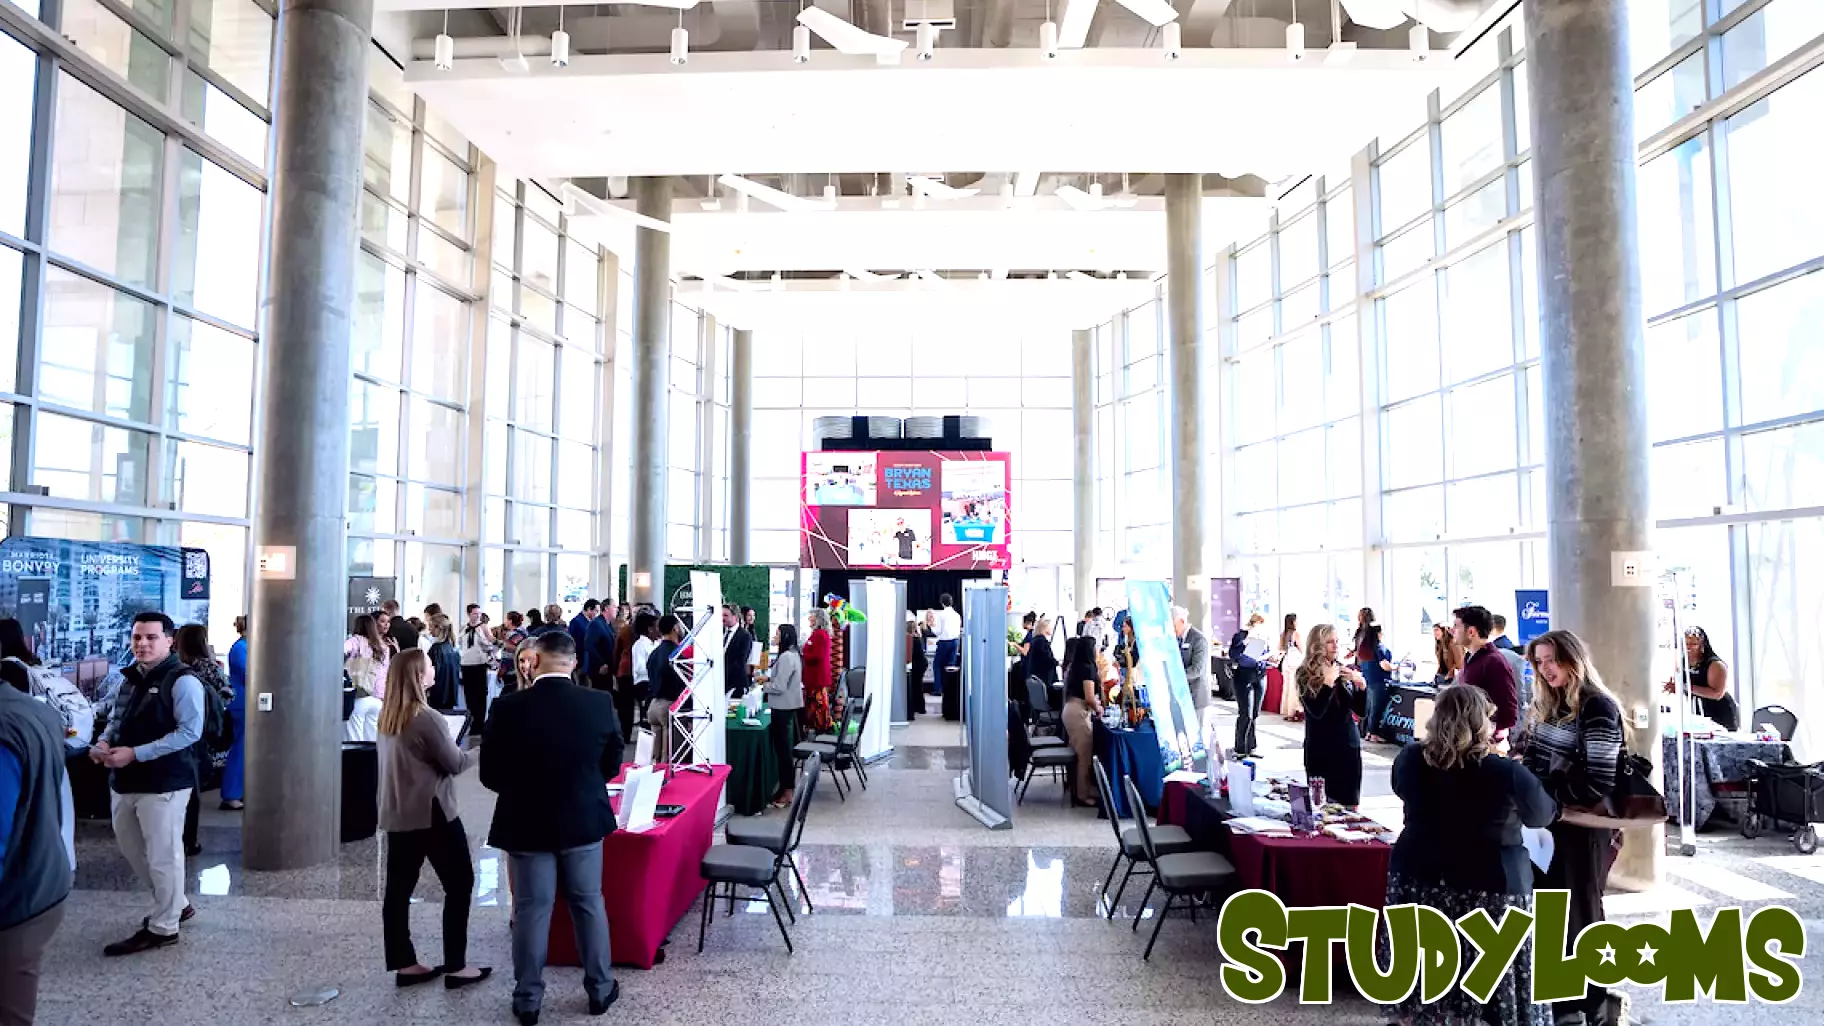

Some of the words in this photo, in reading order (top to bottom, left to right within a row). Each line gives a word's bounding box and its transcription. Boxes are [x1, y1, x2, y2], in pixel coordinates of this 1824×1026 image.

[884, 468, 931, 478] BRYAN
[885, 479, 932, 489] TEXAS
[81, 554, 139, 565] UNIVERSITY
[2, 559, 60, 574] BONVOY
[80, 564, 139, 576] PROGRAMS
